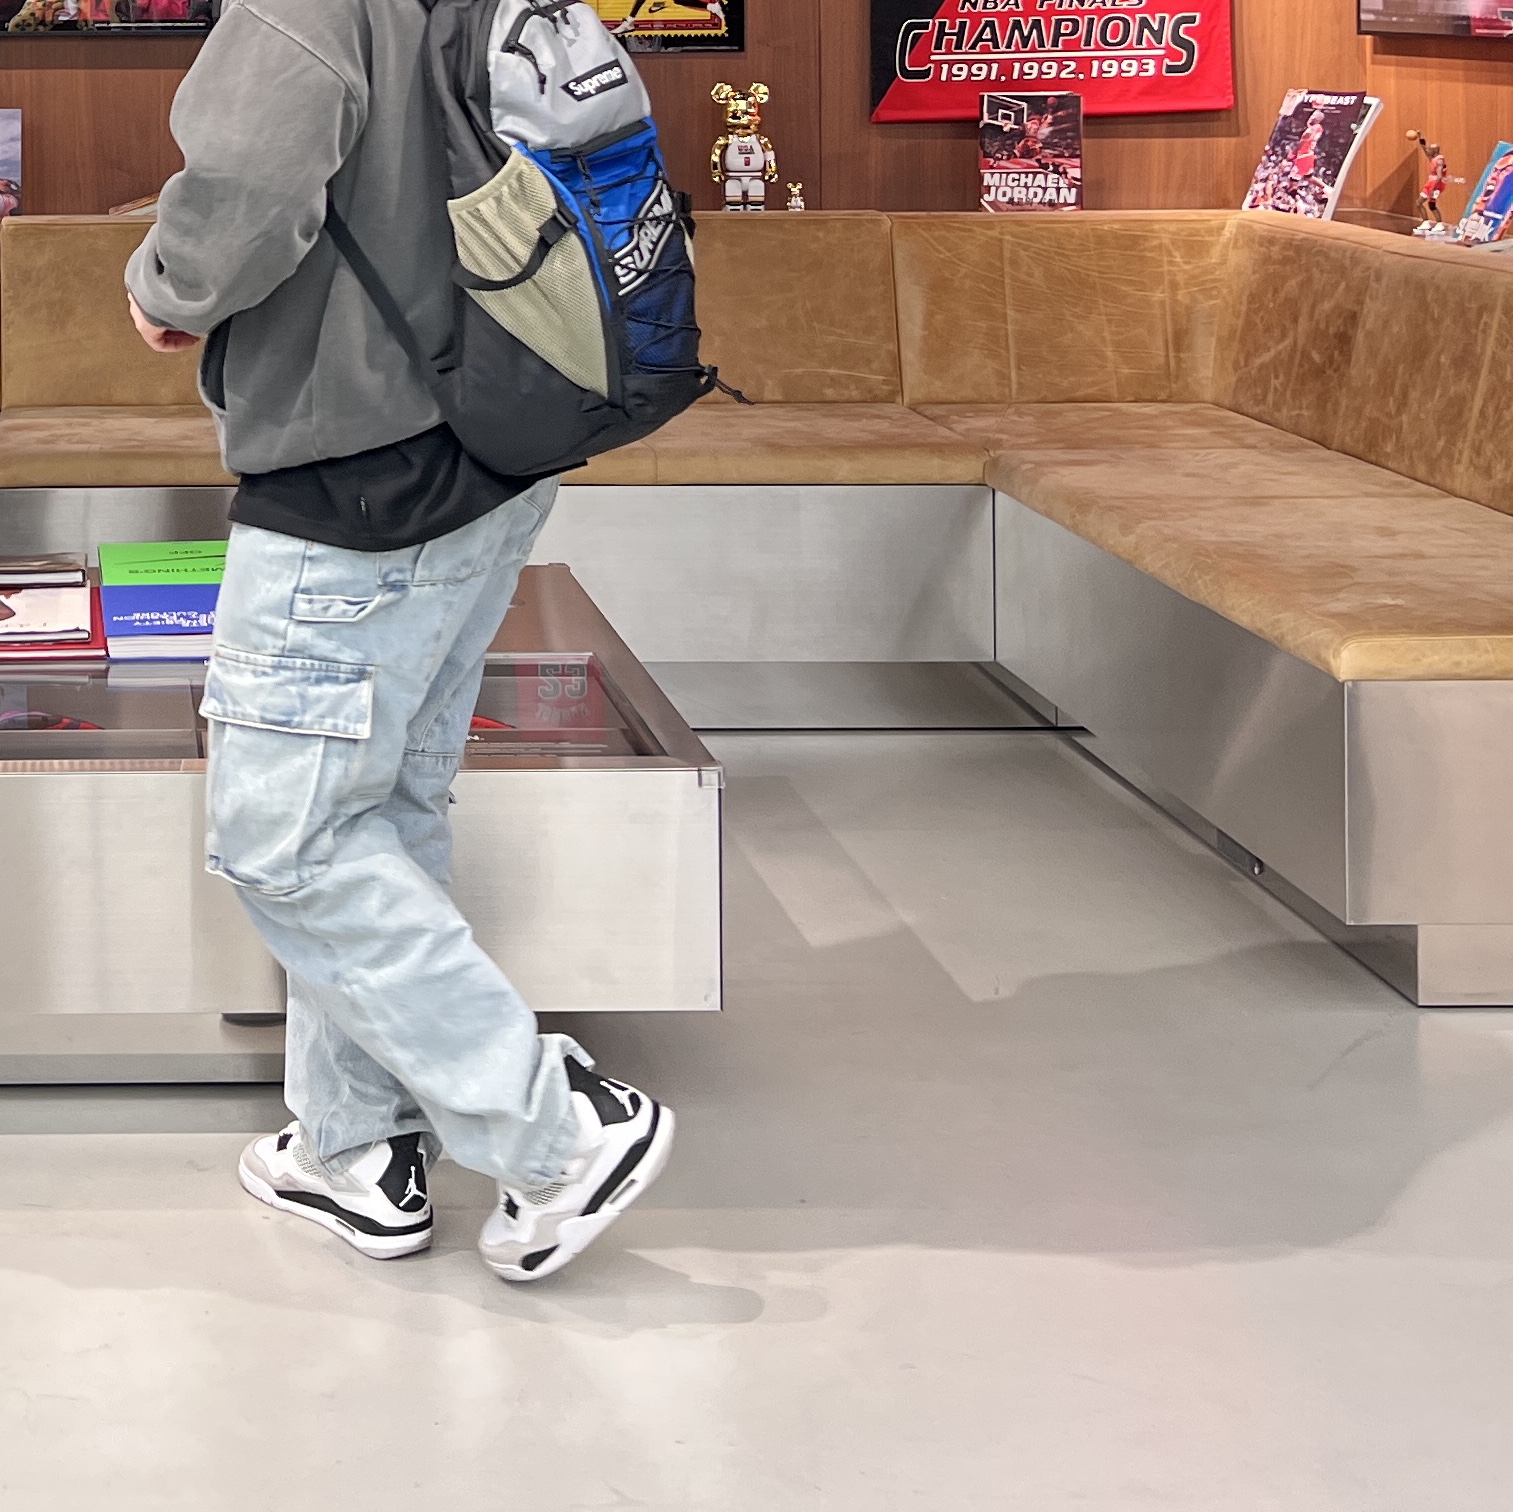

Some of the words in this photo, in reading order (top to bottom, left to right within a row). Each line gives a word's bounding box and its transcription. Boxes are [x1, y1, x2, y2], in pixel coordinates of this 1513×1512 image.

[895, 12, 1202, 82] CHAMPIONS
[568, 66, 623, 96] Supreme
[982, 172, 1069, 188] MICHAEL
[982, 186, 1078, 204] JORDAN
